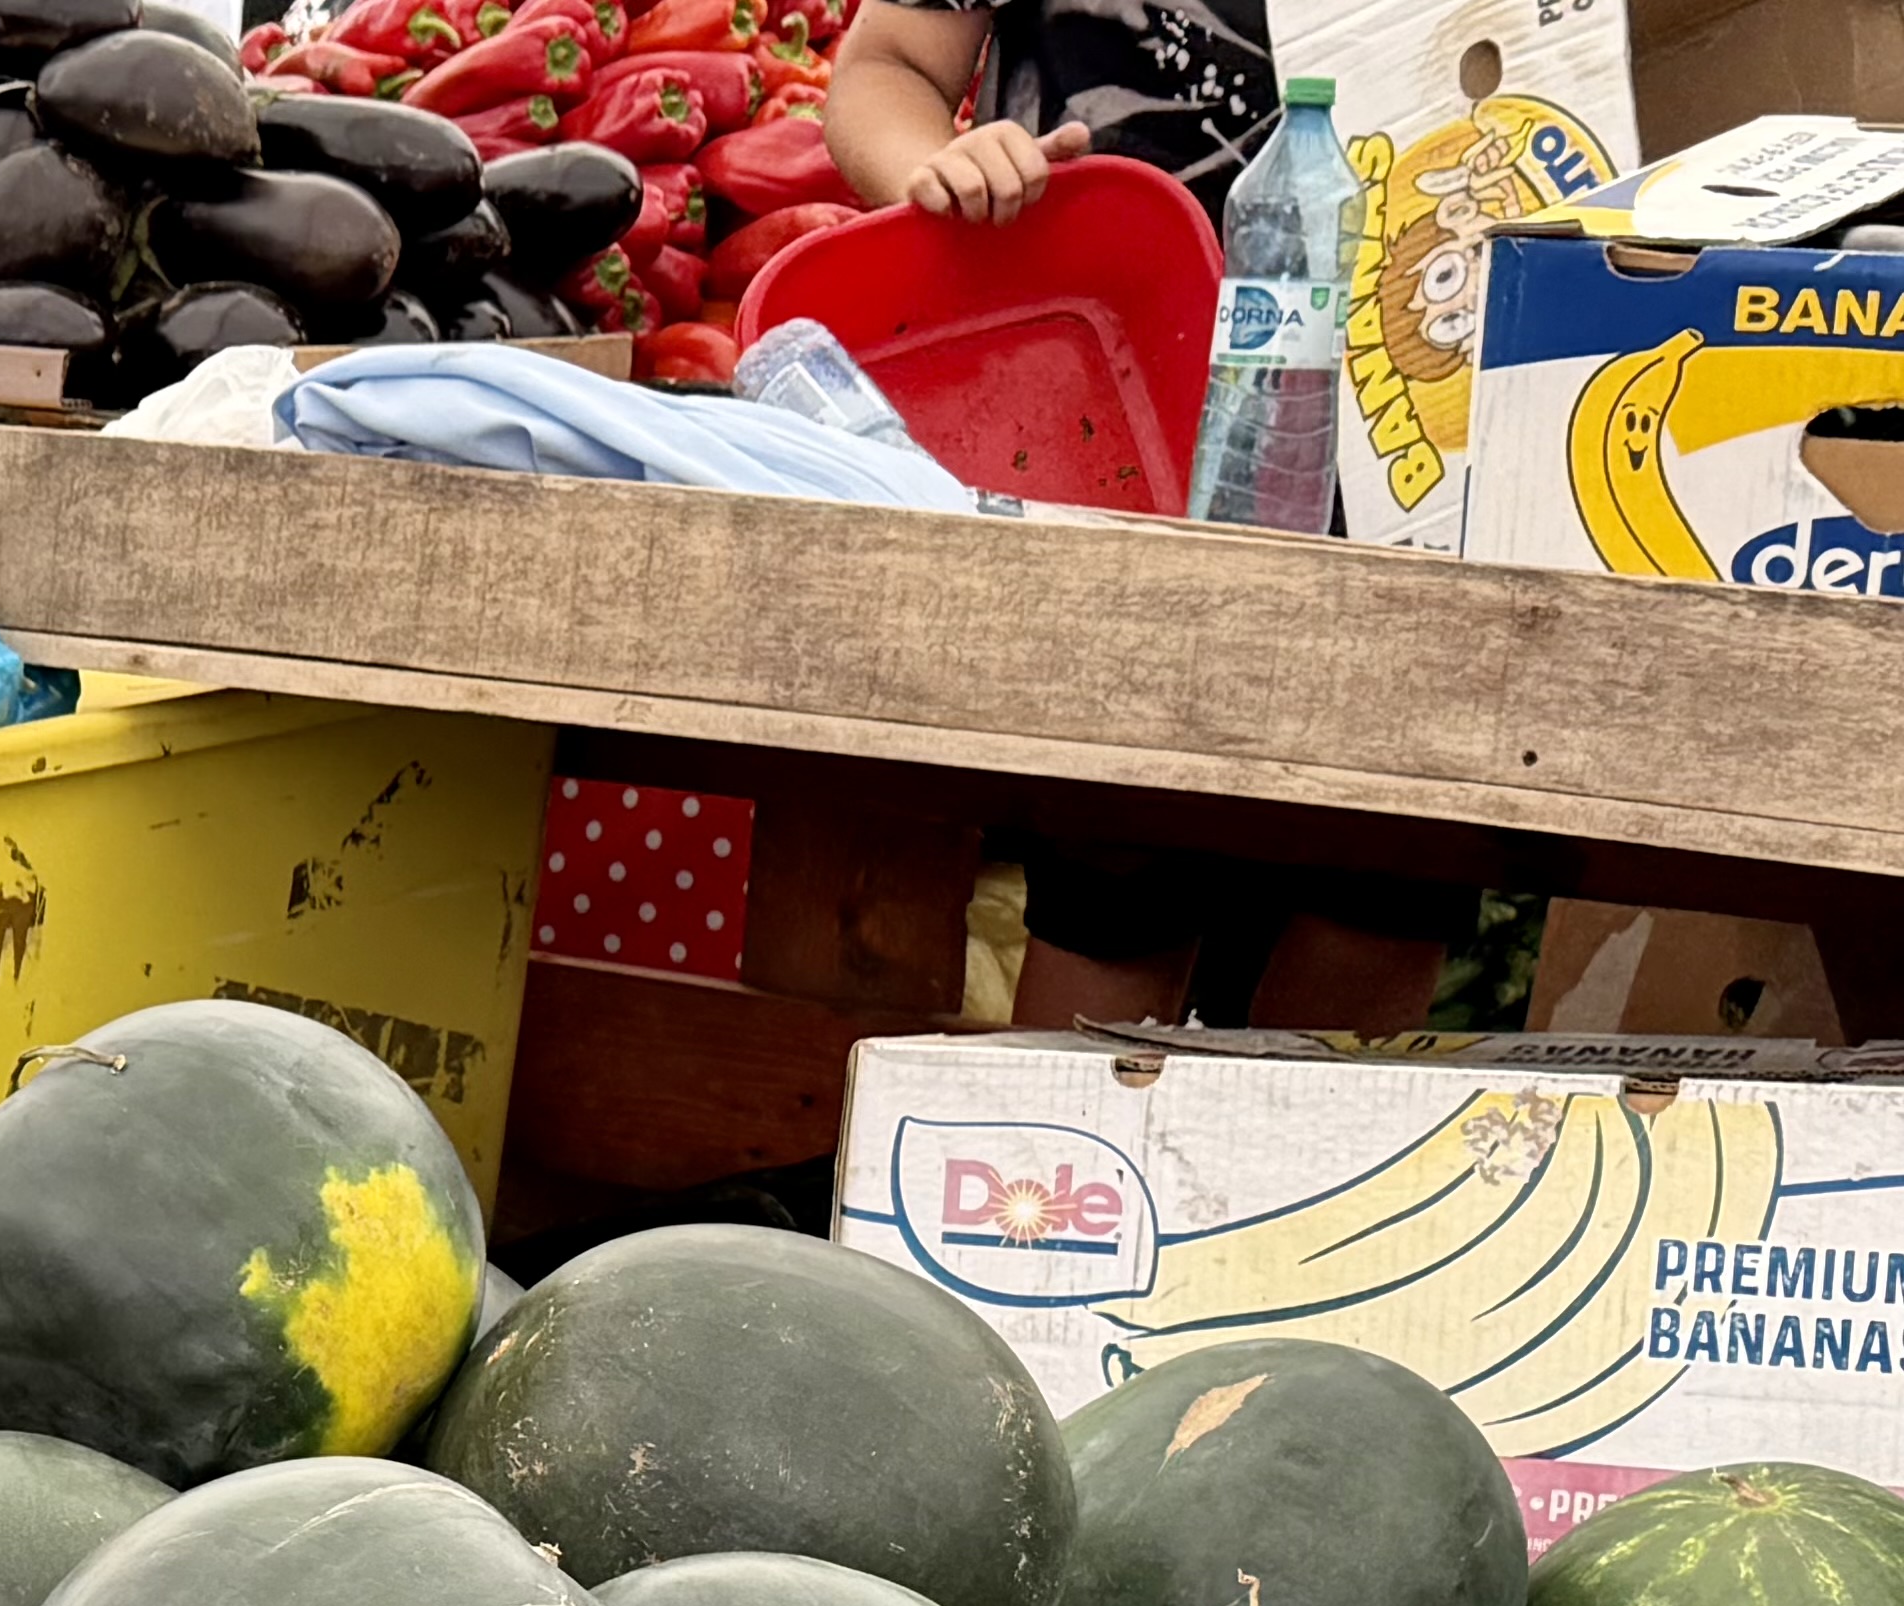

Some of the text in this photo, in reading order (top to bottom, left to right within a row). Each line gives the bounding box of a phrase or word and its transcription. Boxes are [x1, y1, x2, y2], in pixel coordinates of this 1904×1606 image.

[1219, 304, 1305, 327] DORNA
[1339, 131, 1445, 513] BANANAS
[1751, 518, 1904, 595] der
[942, 1158, 1123, 1240] Dole
[1648, 1307, 1904, 1374] BANANA
